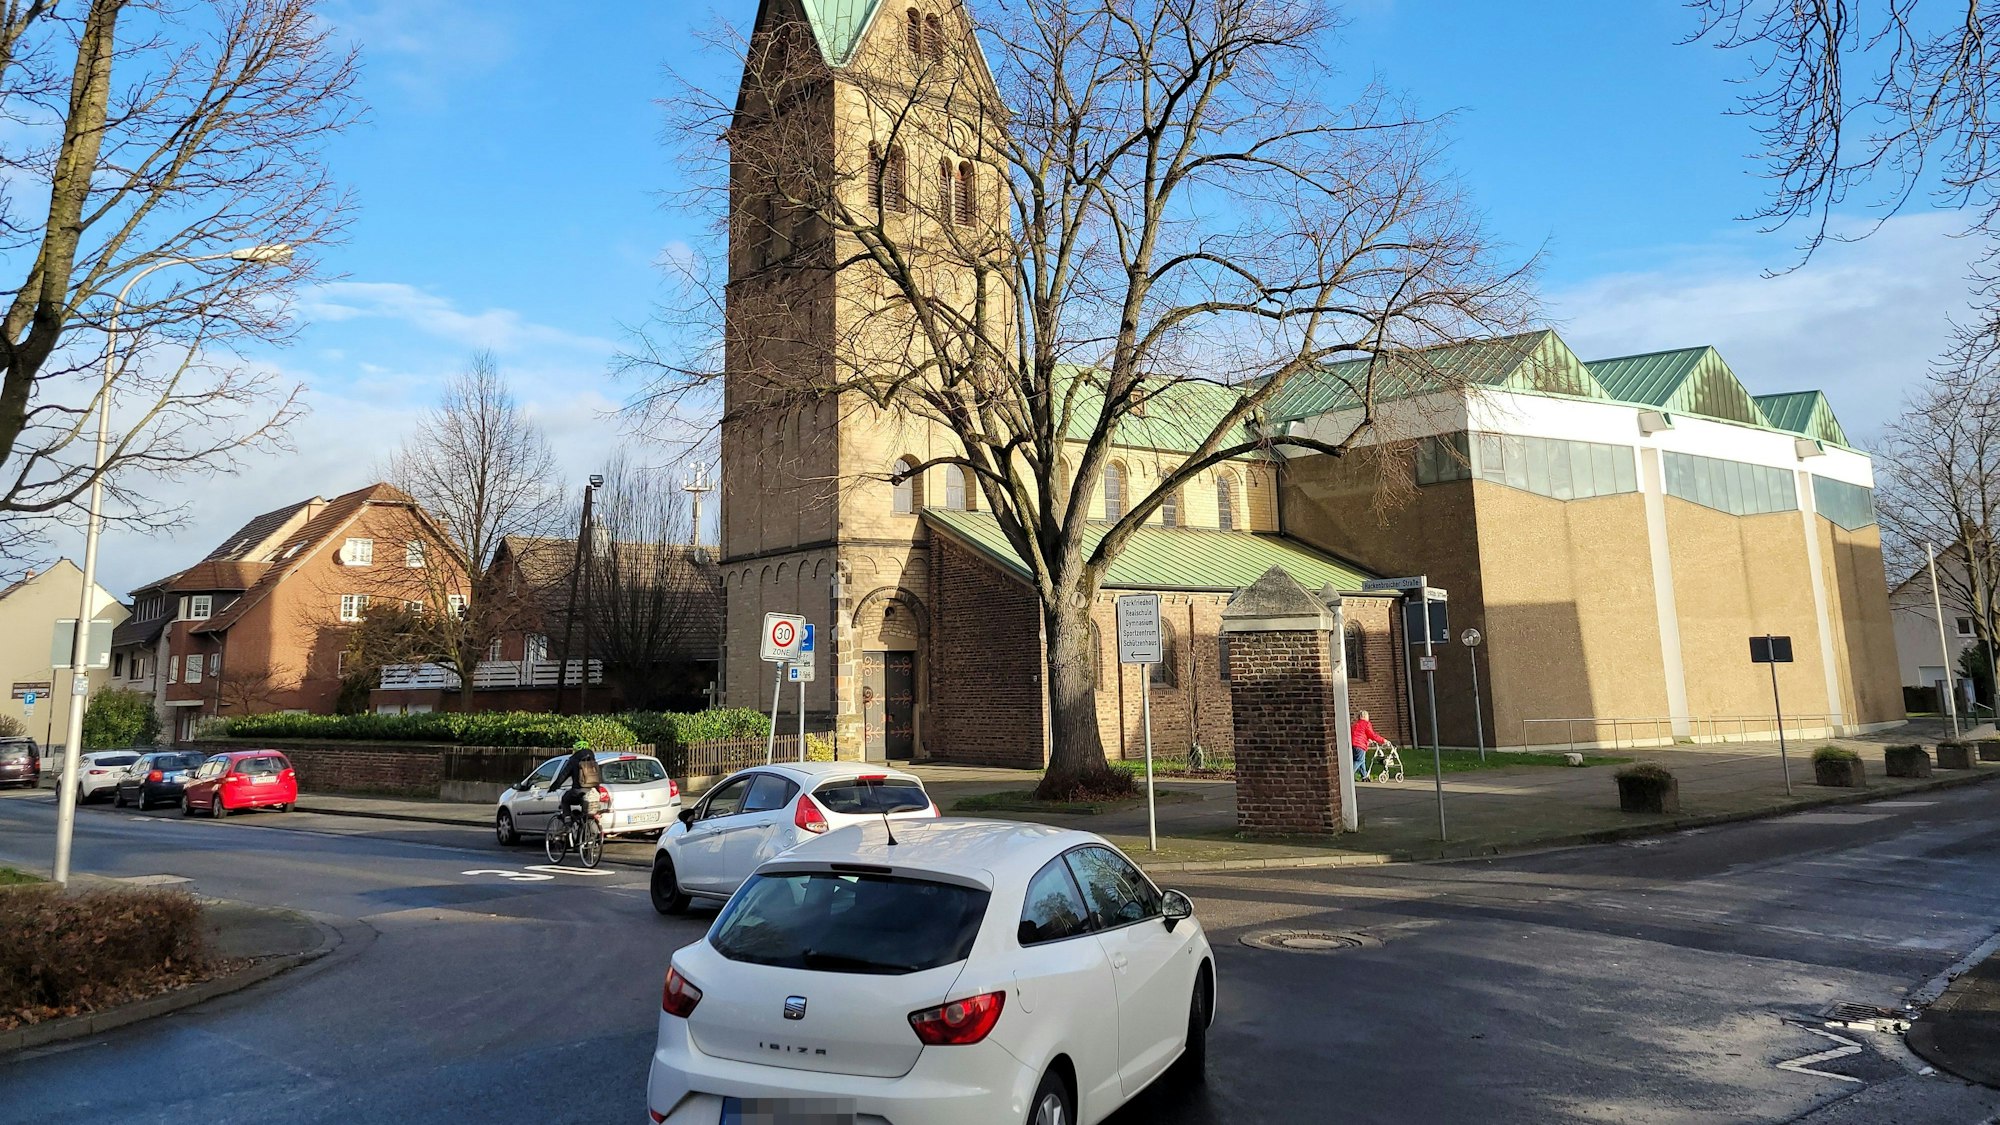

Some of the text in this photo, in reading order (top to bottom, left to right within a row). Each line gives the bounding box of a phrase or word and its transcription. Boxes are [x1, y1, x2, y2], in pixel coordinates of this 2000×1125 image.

[1402, 579, 1419, 587] Straße
[1126, 609, 1152, 617] Realschule
[1126, 619, 1154, 628] Gymnasium
[776, 628, 791, 641] 30
[1123, 630, 1157, 638] Sportzentrum
[772, 648, 791, 657] ZONE
[26, 695, 34, 704] P
[461, 865, 616, 881] 30
[759, 1041, 827, 1056] IBIZA
